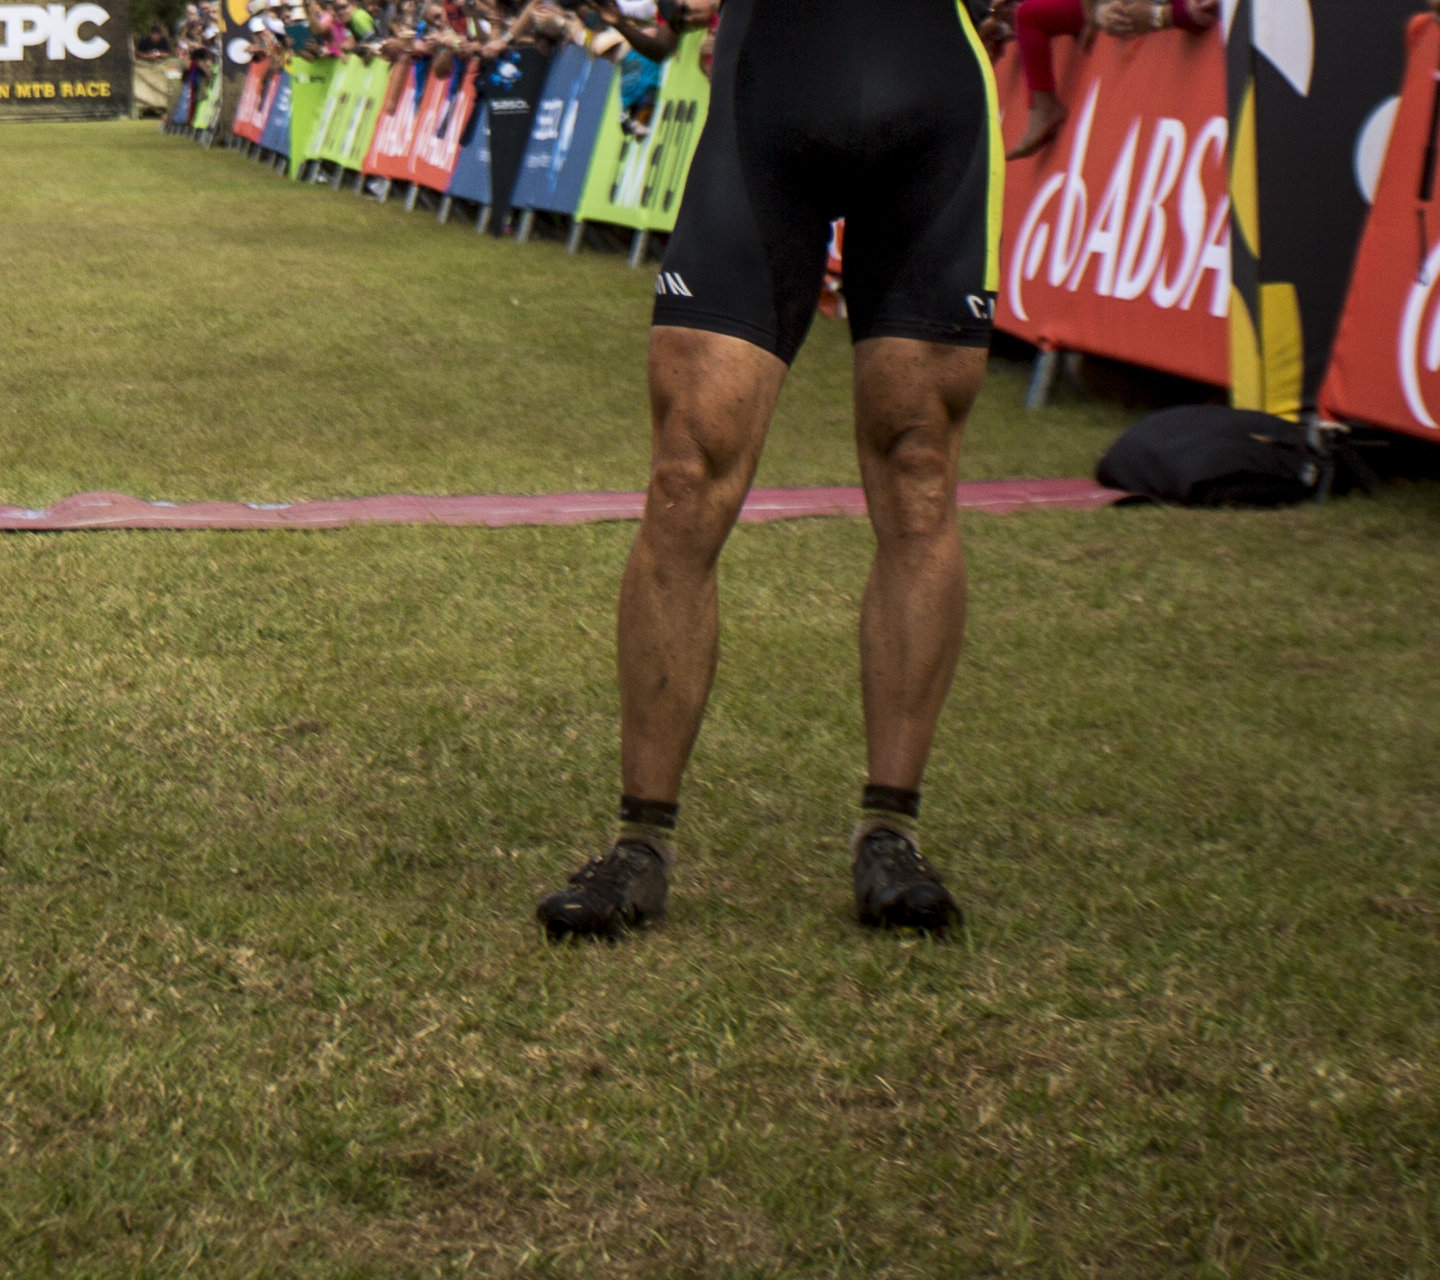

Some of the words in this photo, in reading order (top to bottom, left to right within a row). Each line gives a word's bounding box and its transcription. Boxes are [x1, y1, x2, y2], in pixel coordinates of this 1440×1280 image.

[15, 83, 56, 100] MTB
[60, 81, 112, 99] RACE
[1066, 113, 1231, 318] ABSA
